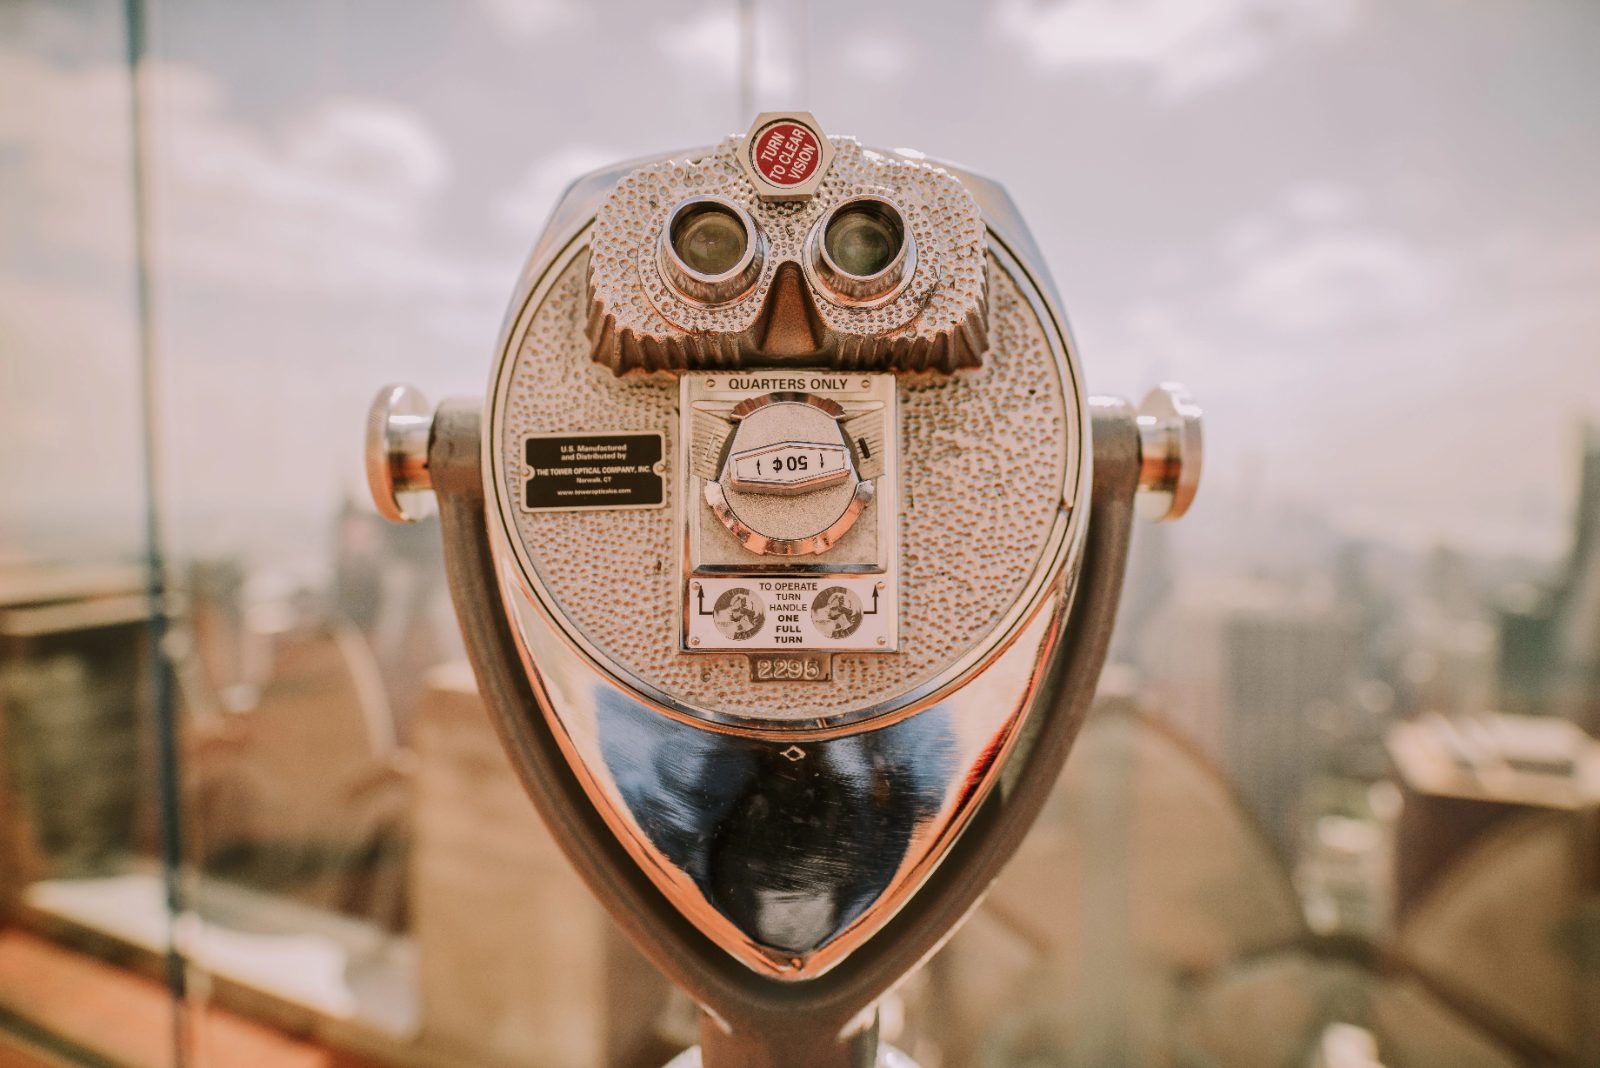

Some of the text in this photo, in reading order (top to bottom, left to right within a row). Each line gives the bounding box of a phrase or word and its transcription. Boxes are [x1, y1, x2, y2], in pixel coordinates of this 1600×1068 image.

[760, 131, 785, 162] TURN
[769, 128, 806, 180] TO CLEAR
[788, 143, 816, 179] VISION
[728, 378, 848, 390] QUARTERS ONLY
[560, 444, 627, 453] U.S. Manufactured
[561, 453, 575, 461] and
[617, 452, 627, 460] by
[536, 465, 651, 476] THE TOWER OPTICAL COMPANY, INC.
[759, 582, 818, 591] TO OPERATE
[776, 593, 801, 601] TURN
[769, 603, 808, 612] HANDLE
[777, 614, 799, 623] ONE
[776, 625, 802, 633] FULL
[774, 636, 803, 644] TURN
[757, 658, 820, 680] 2295
